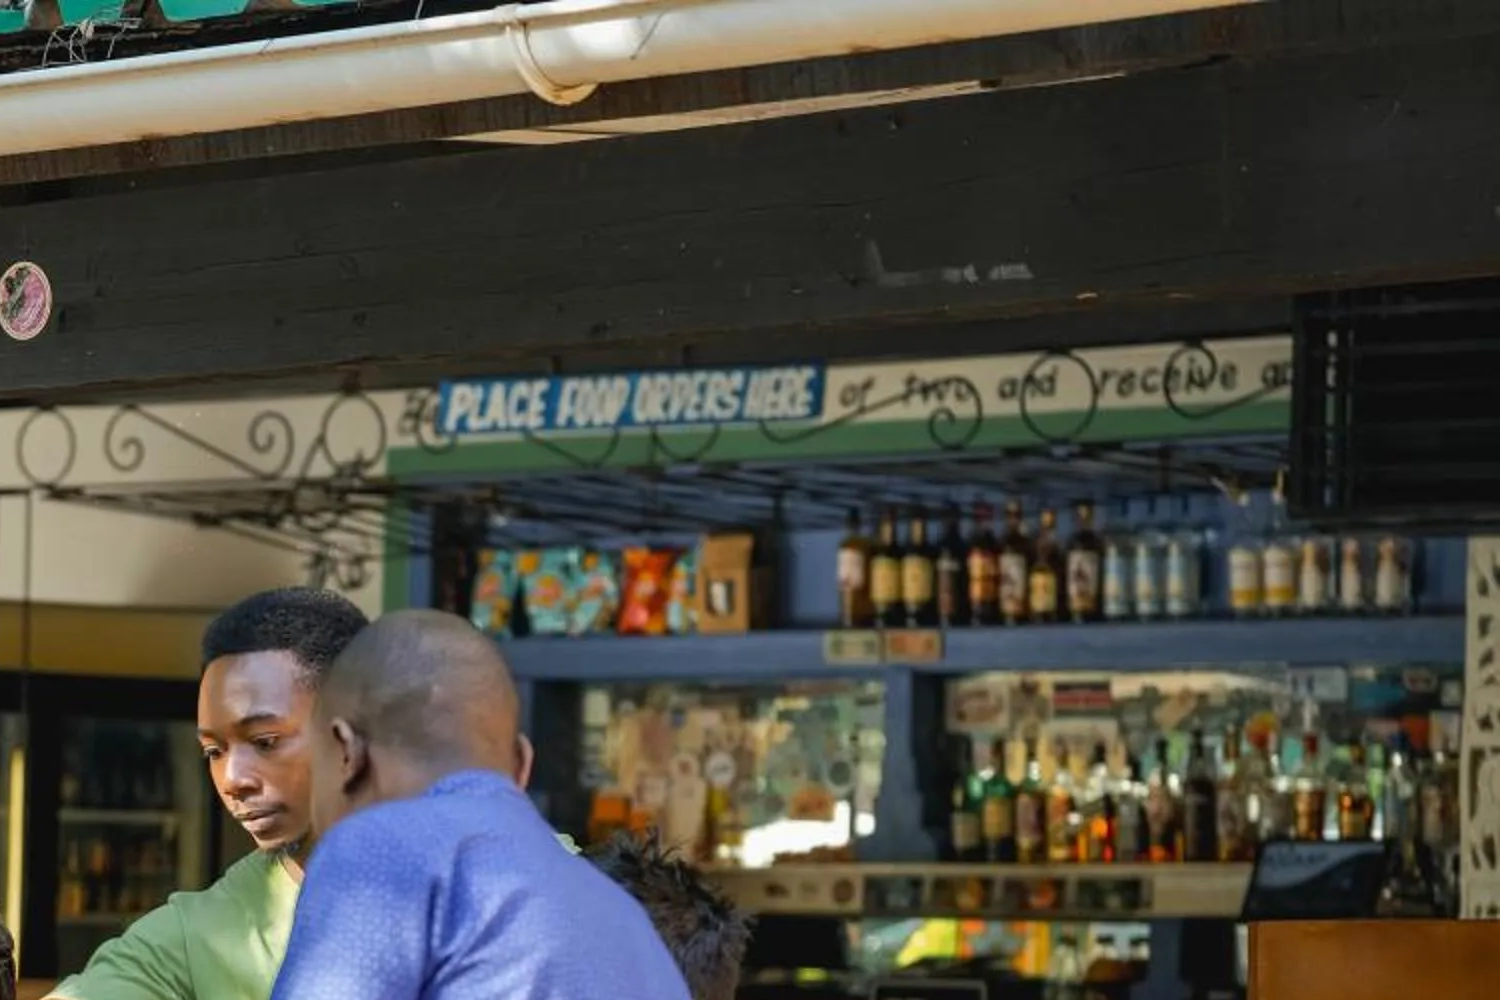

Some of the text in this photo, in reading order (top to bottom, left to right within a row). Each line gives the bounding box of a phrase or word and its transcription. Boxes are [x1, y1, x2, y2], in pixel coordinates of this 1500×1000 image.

[444, 379, 550, 432] PLACE
[555, 375, 631, 426] FOOD
[633, 370, 745, 423] ORDERS
[743, 366, 817, 419] HERE
